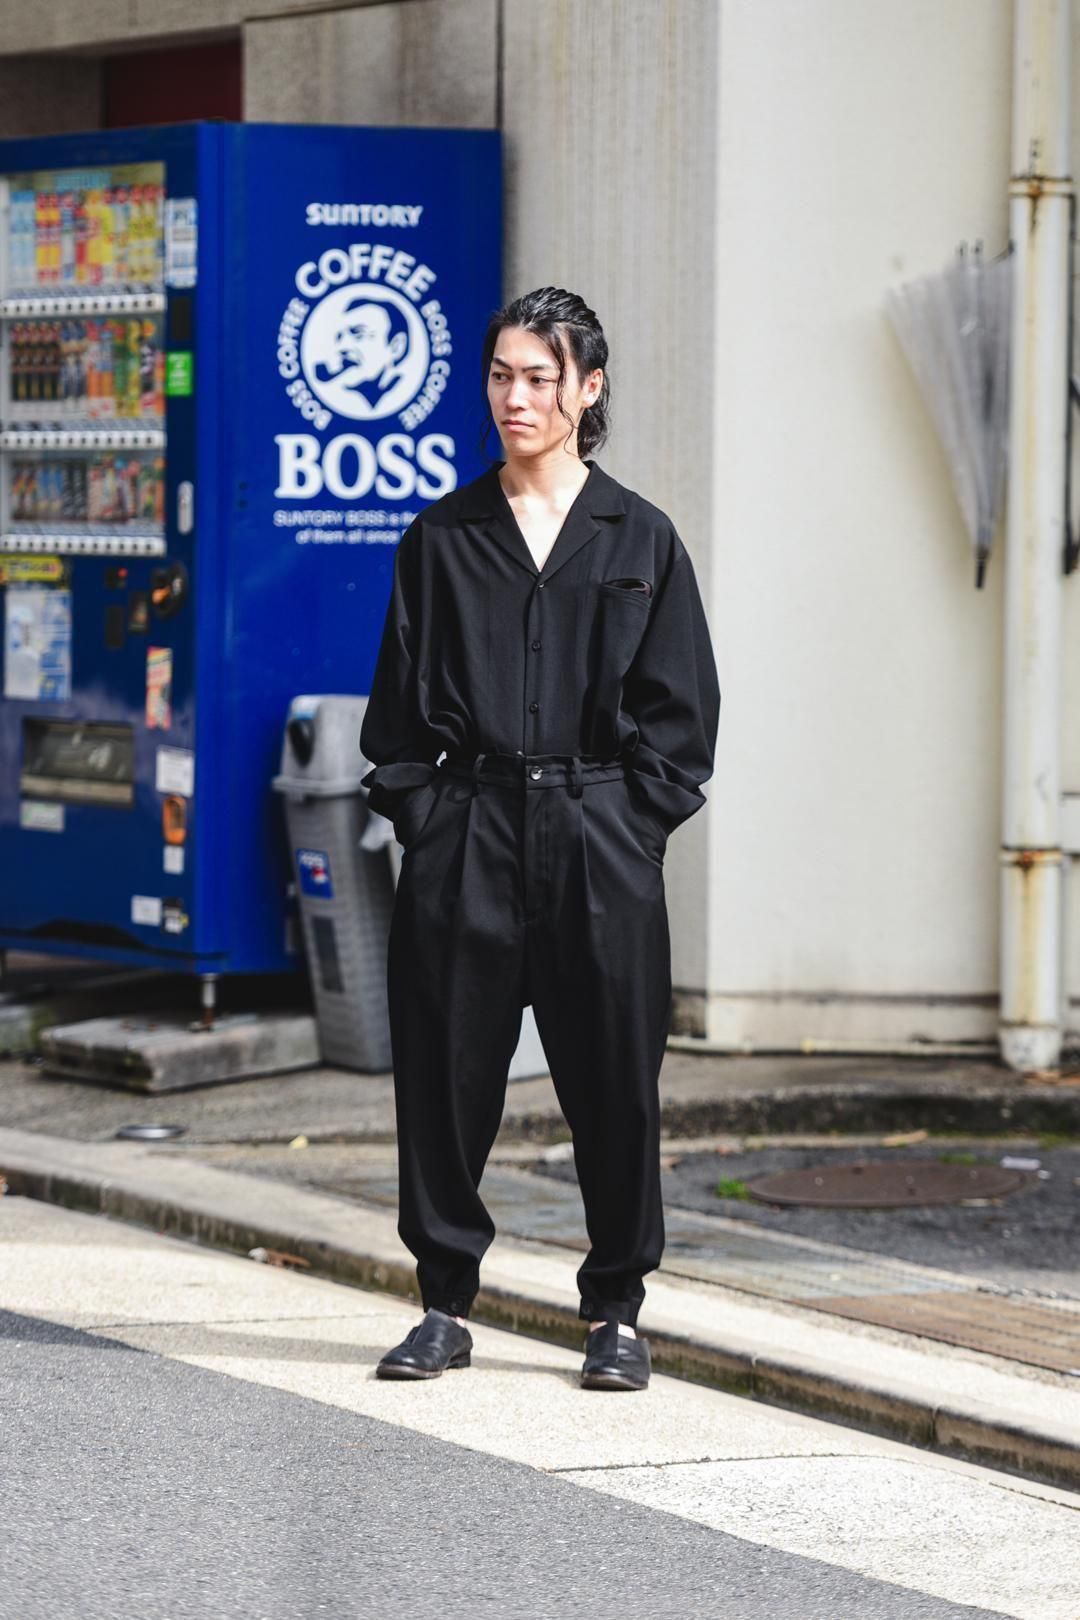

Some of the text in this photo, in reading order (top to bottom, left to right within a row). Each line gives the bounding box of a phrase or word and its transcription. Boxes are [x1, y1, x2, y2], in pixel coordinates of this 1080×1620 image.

[305, 203, 423, 228] SUNTORY
[295, 243, 437, 301] COFFEE
[276, 297, 333, 431] BOSS COFFEE
[397, 299, 453, 431] BOSS COFFEE
[274, 433, 458, 501] BOSS
[273, 509, 343, 527] SUNTORY
[345, 509, 388, 527] BOSS
